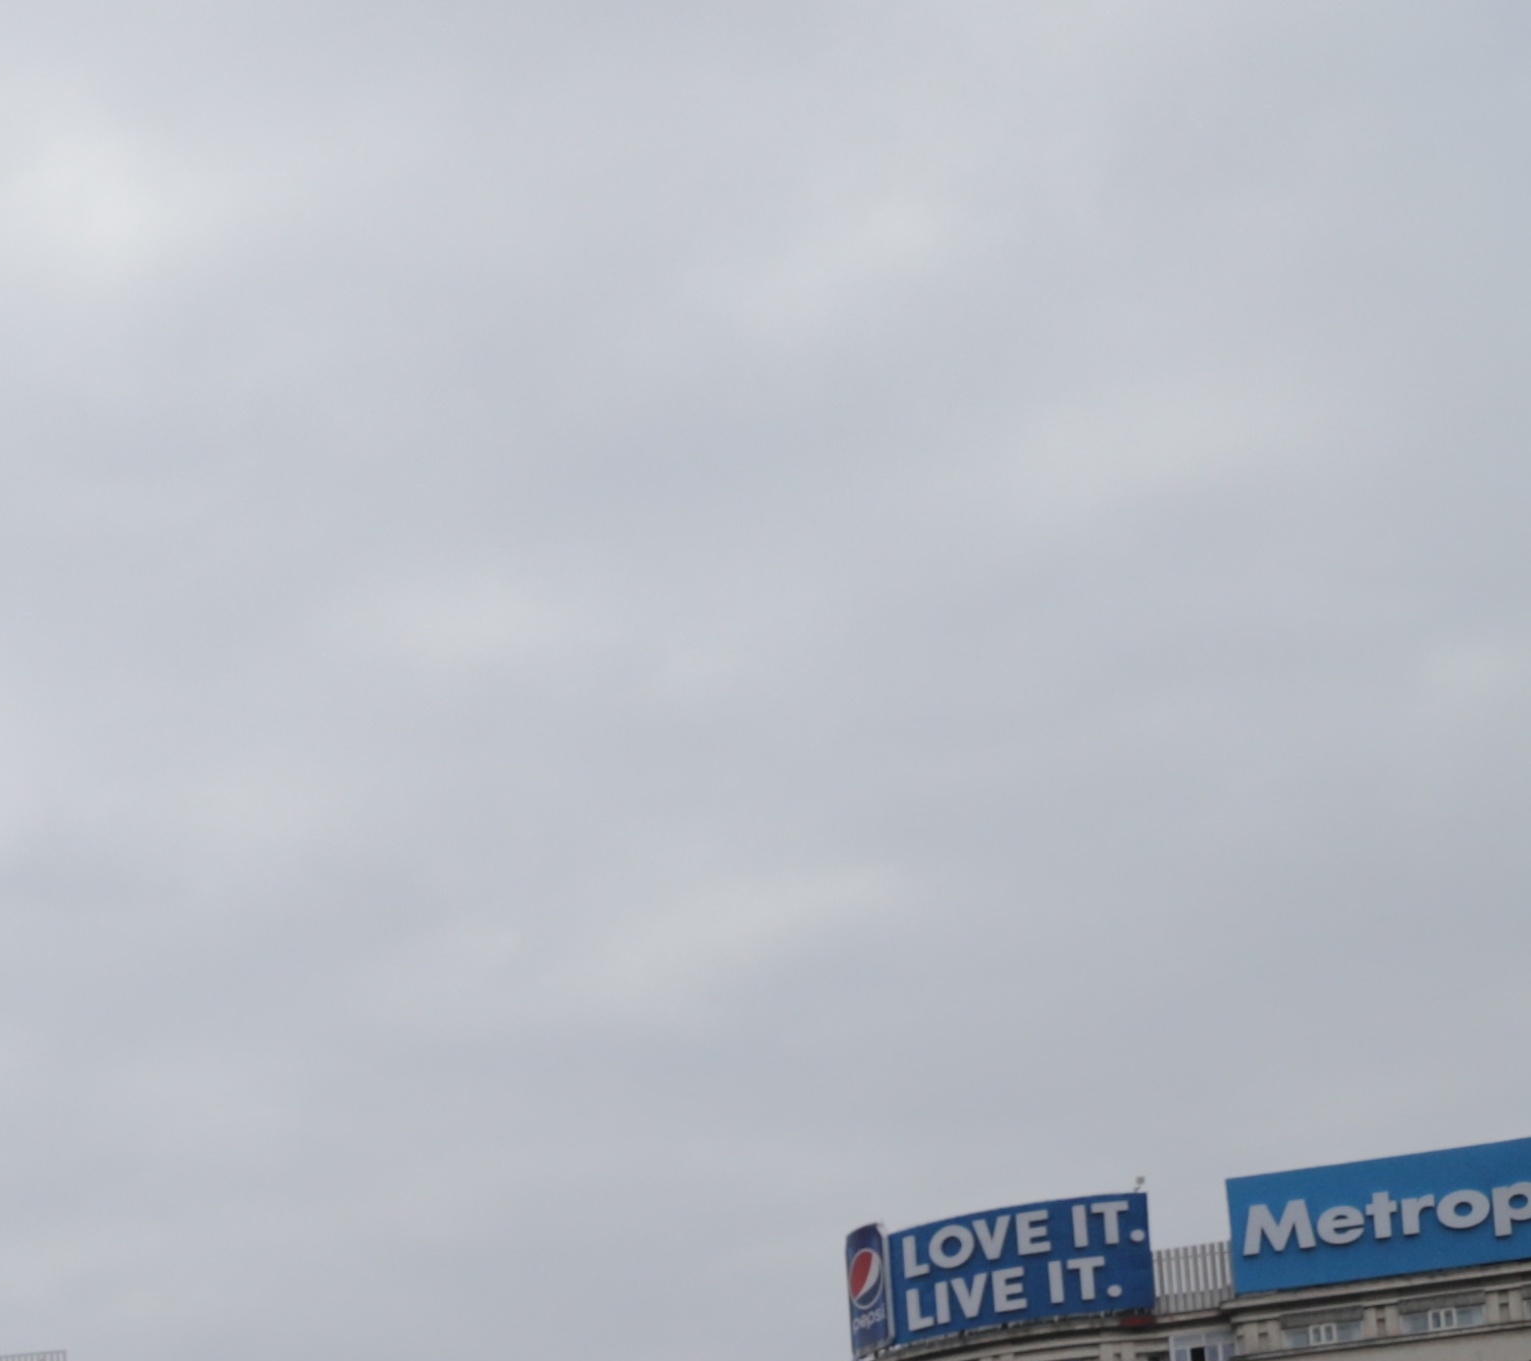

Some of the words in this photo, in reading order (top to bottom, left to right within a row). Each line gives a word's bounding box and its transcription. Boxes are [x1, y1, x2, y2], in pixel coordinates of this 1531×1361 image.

[902, 1209, 1052, 1279] LOVE
[1071, 1200, 1146, 1249] IT.
[1243, 1181, 1531, 1257] Metrop
[852, 1307, 887, 1332] pepsi
[905, 1266, 1028, 1332] LIVE
[1047, 1255, 1123, 1304] IT.
